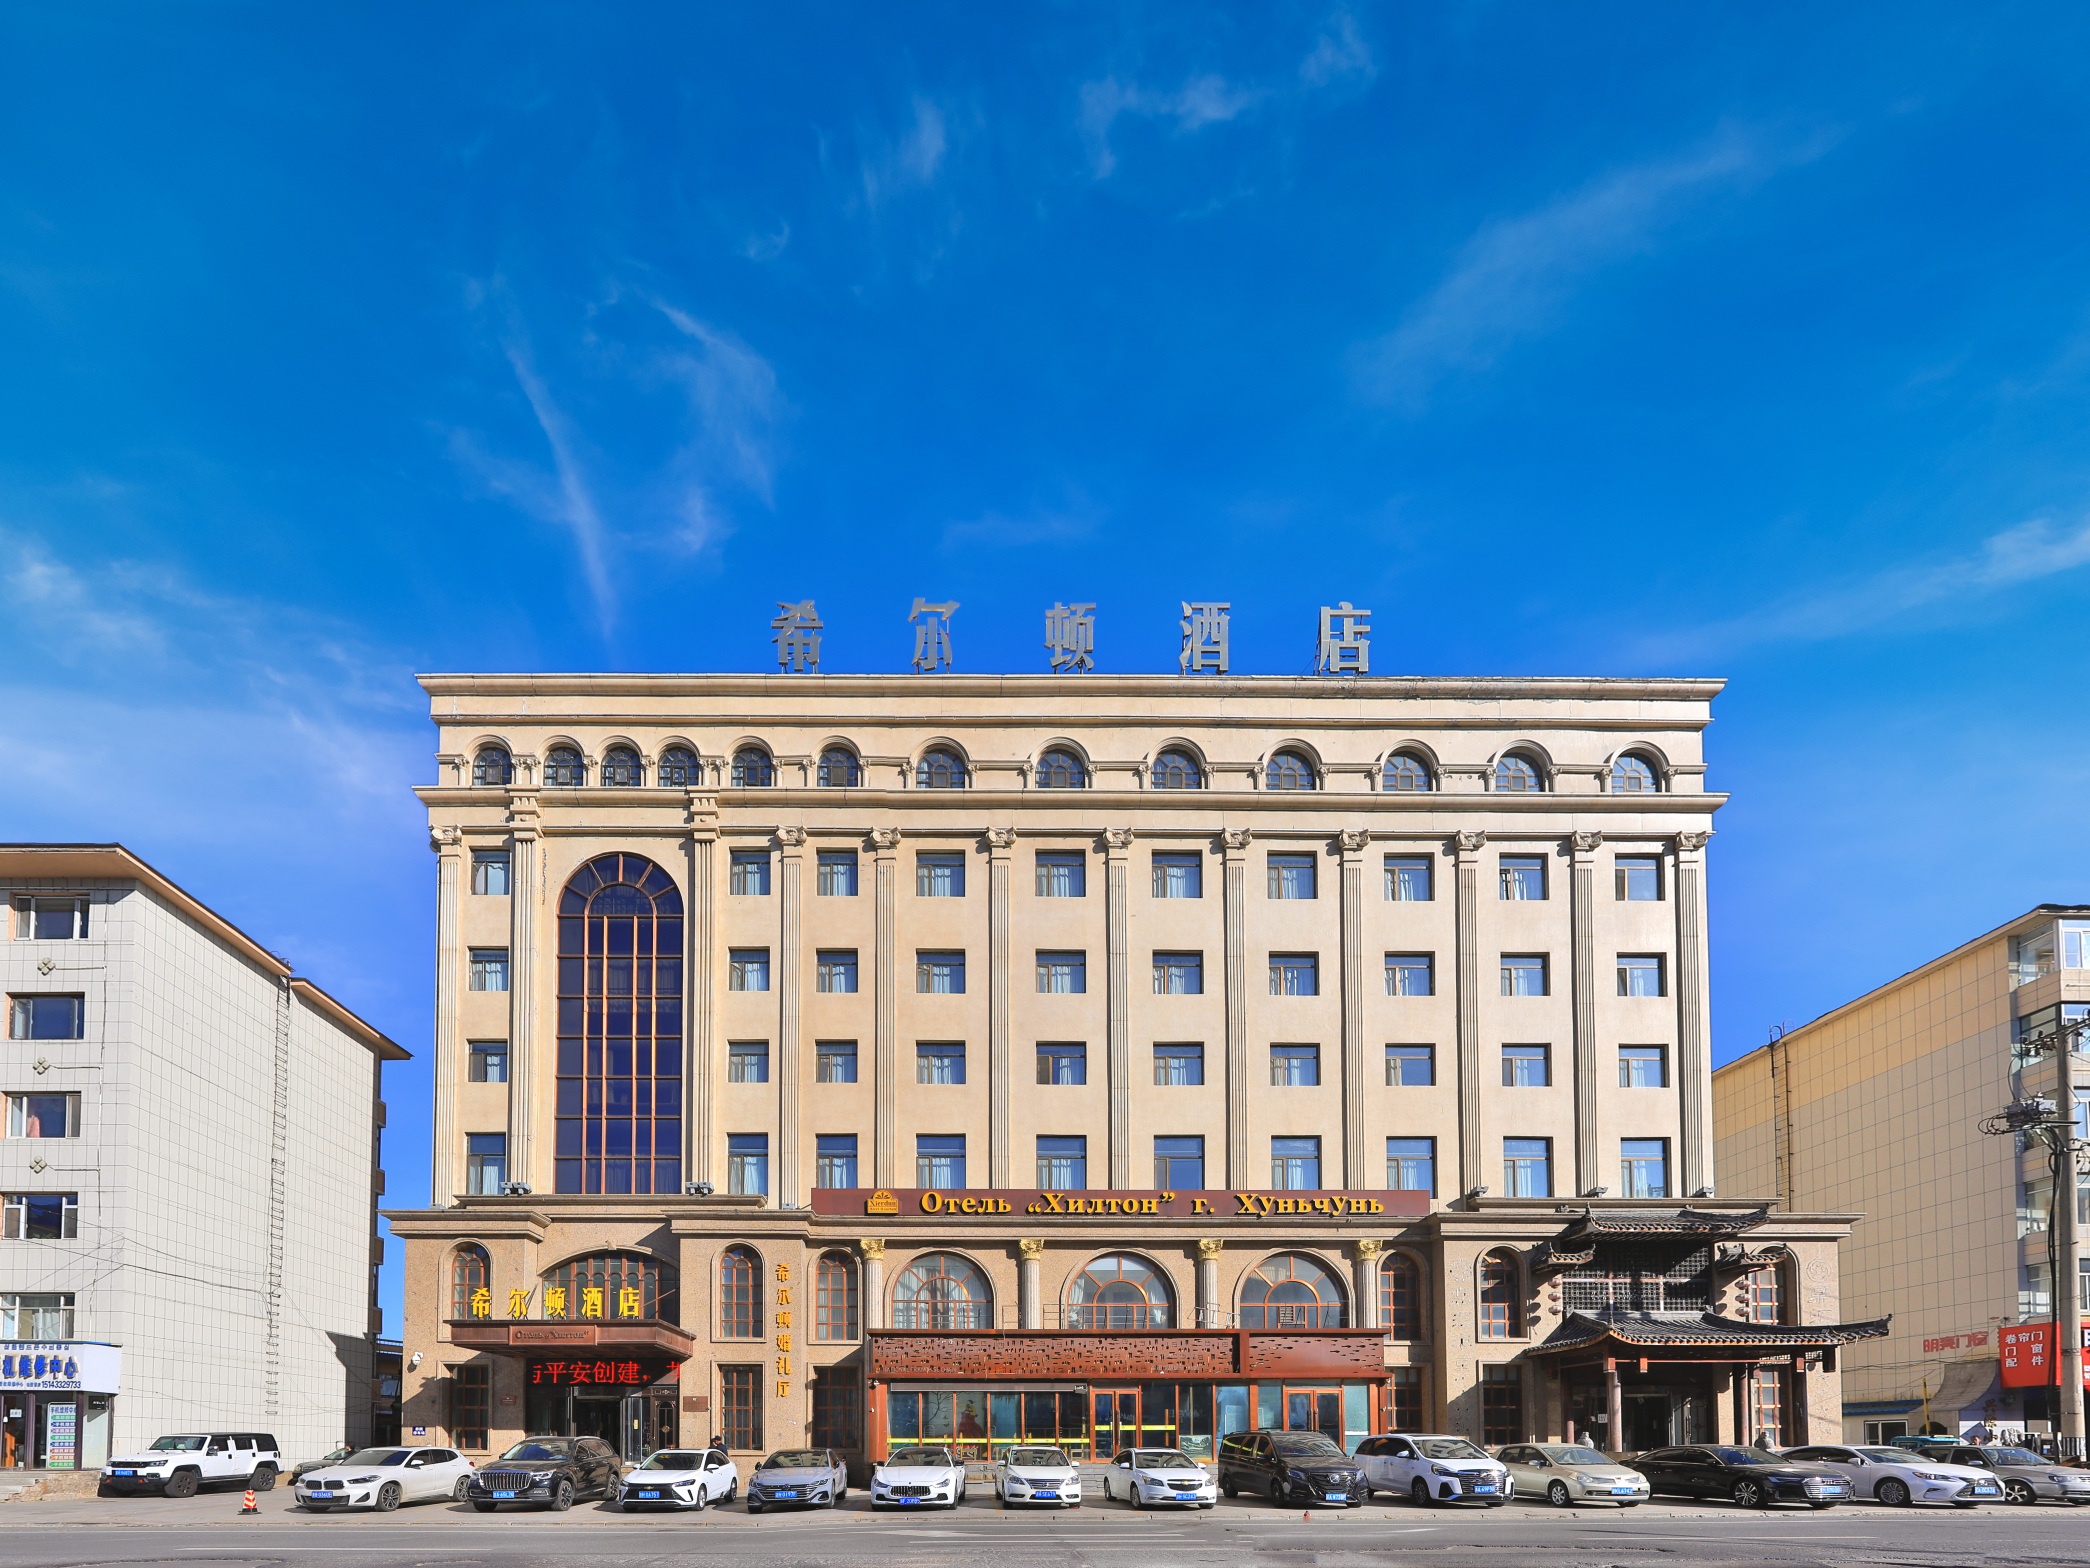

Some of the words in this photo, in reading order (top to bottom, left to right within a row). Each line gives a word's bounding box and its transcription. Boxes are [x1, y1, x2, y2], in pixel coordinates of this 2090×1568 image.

[770, 598, 1371, 673] 希尔顿酒店
[921, 1192, 1012, 1214] Отель
[1193, 1199, 1215, 1214] г.
[1236, 1194, 1385, 1216] Хуньчунь
[471, 1287, 640, 1318] 希尔顿酒店
[775, 1263, 792, 1397] 希尔顿婚礼厅
[1923, 1330, 1989, 1353] 明亮门窗
[2005, 1331, 2044, 1344] 卷帘门
[41, 1381, 81, 1389] 15143329733
